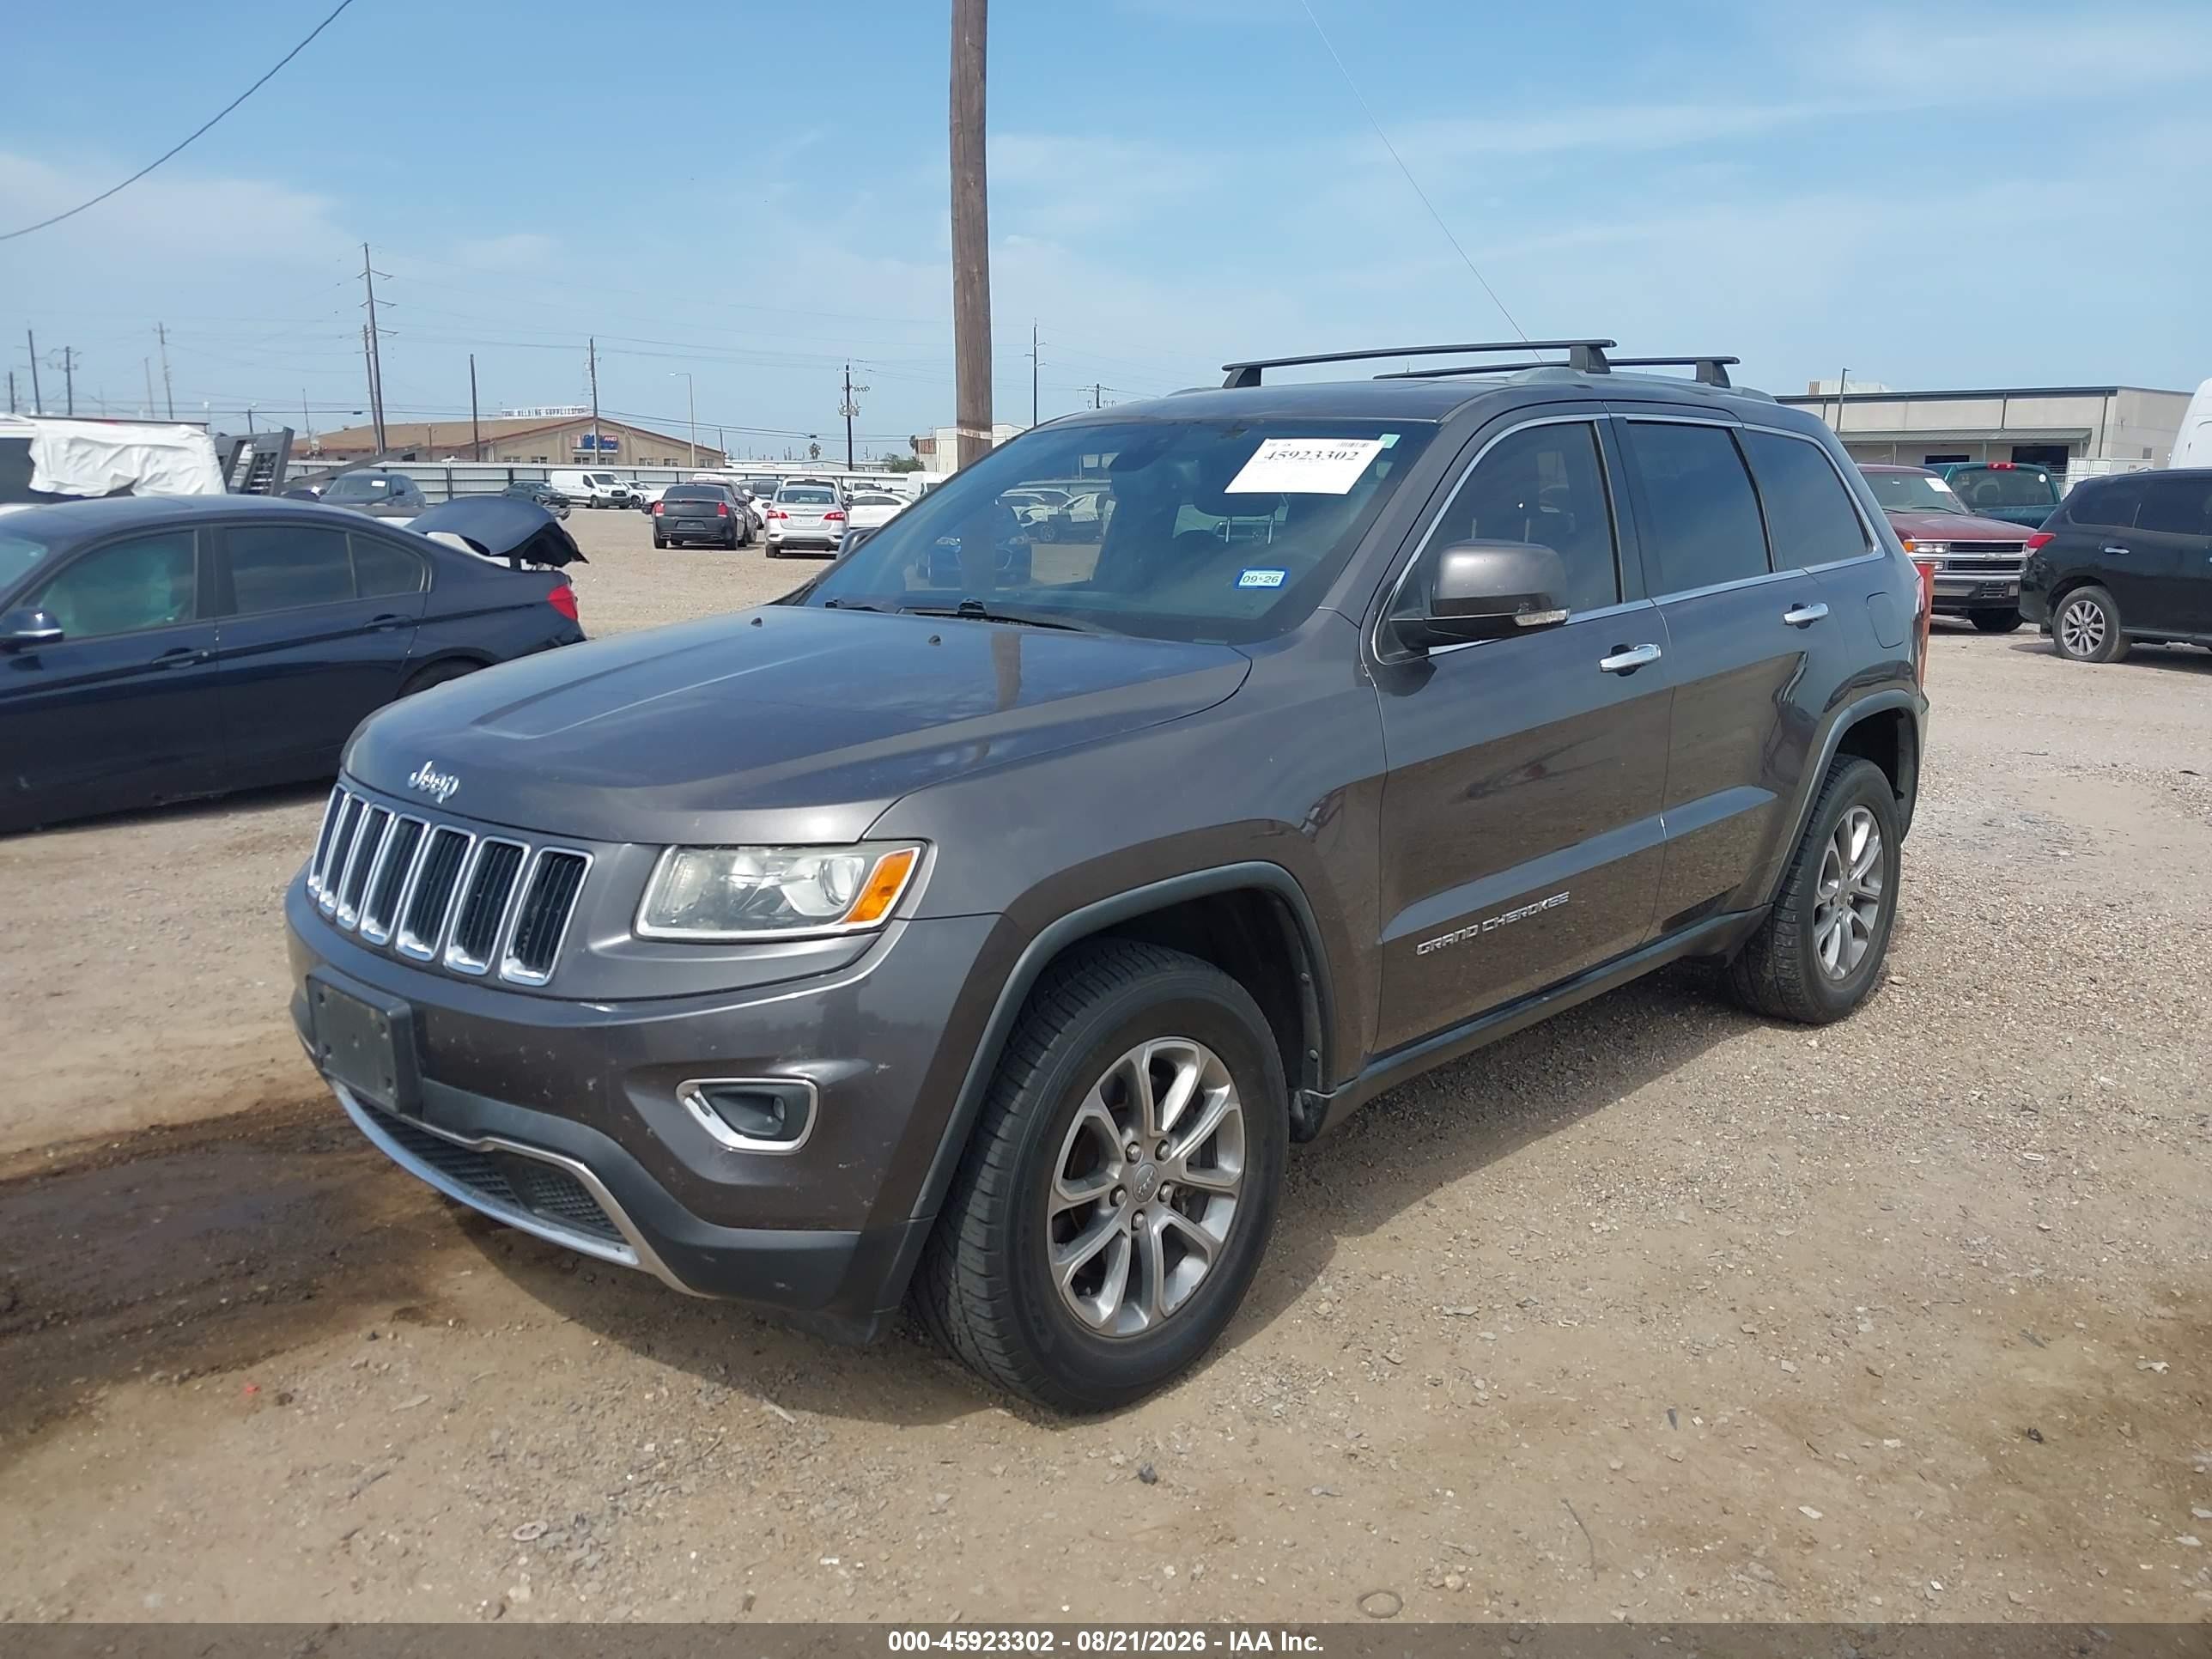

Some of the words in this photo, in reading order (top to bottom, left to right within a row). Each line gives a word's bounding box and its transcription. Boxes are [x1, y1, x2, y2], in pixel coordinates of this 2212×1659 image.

[1264, 449, 1359, 461] 45923302
[408, 760, 459, 804] Jeep
[1415, 923, 1480, 956] GRAND
[1481, 890, 1571, 933] CHEROKEE
